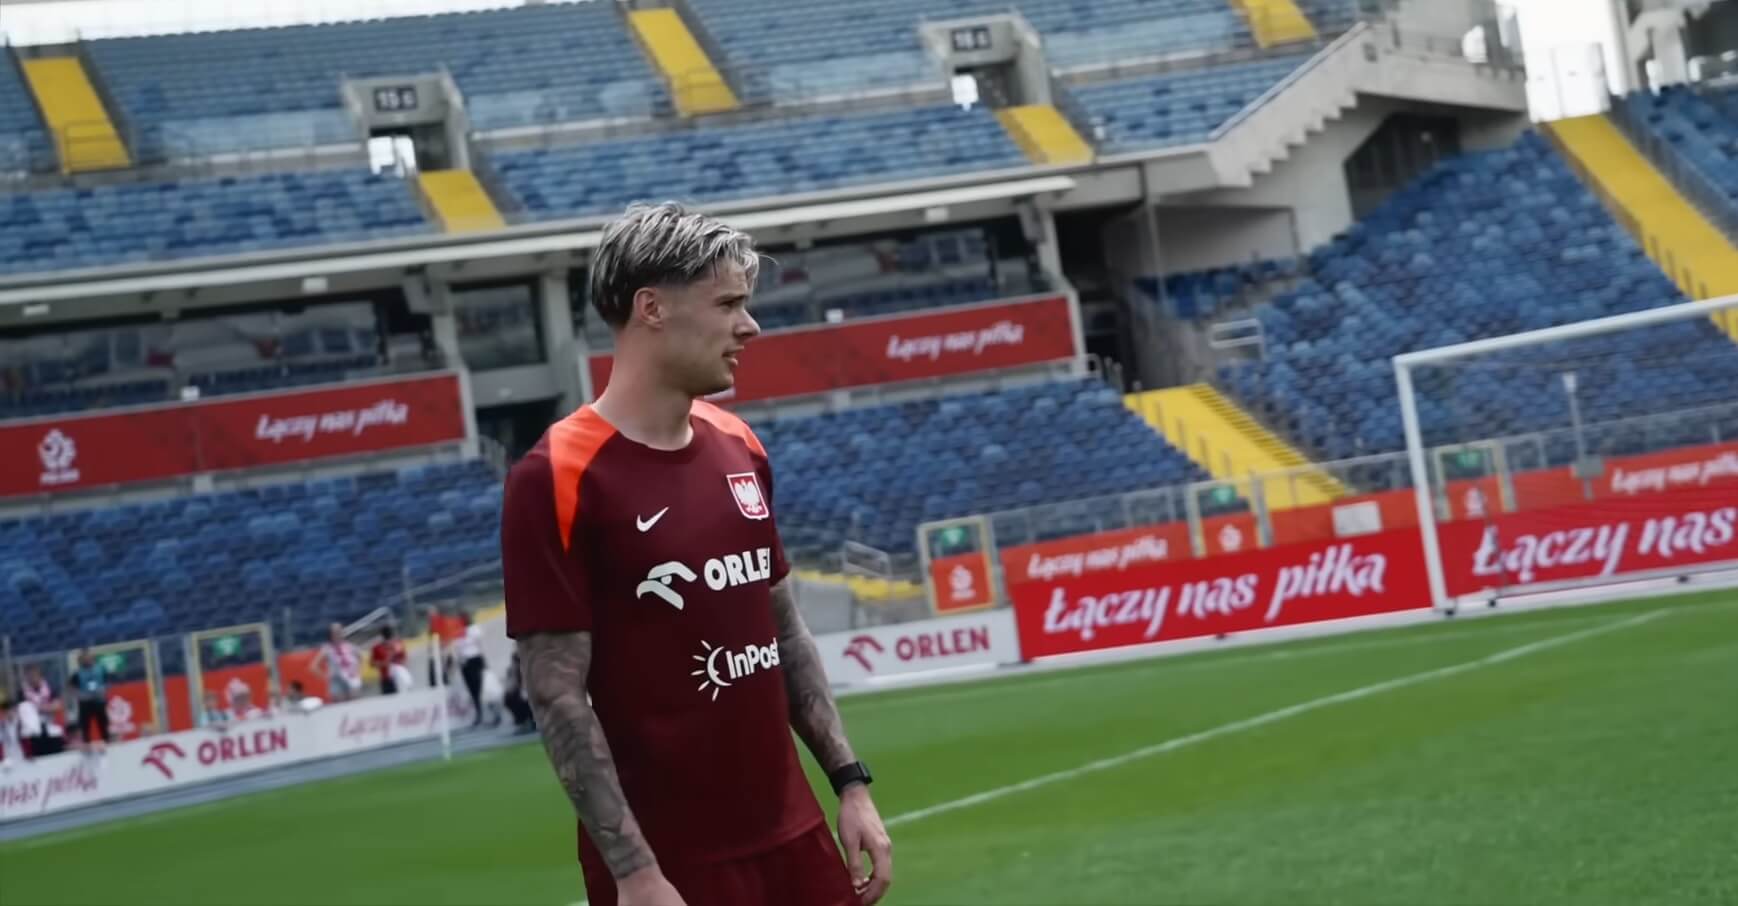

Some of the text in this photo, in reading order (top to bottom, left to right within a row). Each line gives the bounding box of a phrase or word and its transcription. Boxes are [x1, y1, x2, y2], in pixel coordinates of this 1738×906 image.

[1472, 507, 1738, 583] Łączy nas
[703, 547, 771, 591] ORLE
[1043, 542, 1387, 641] Łączy nas piłka
[895, 624, 991, 662] ORLEN
[196, 728, 288, 767] ORLEN
